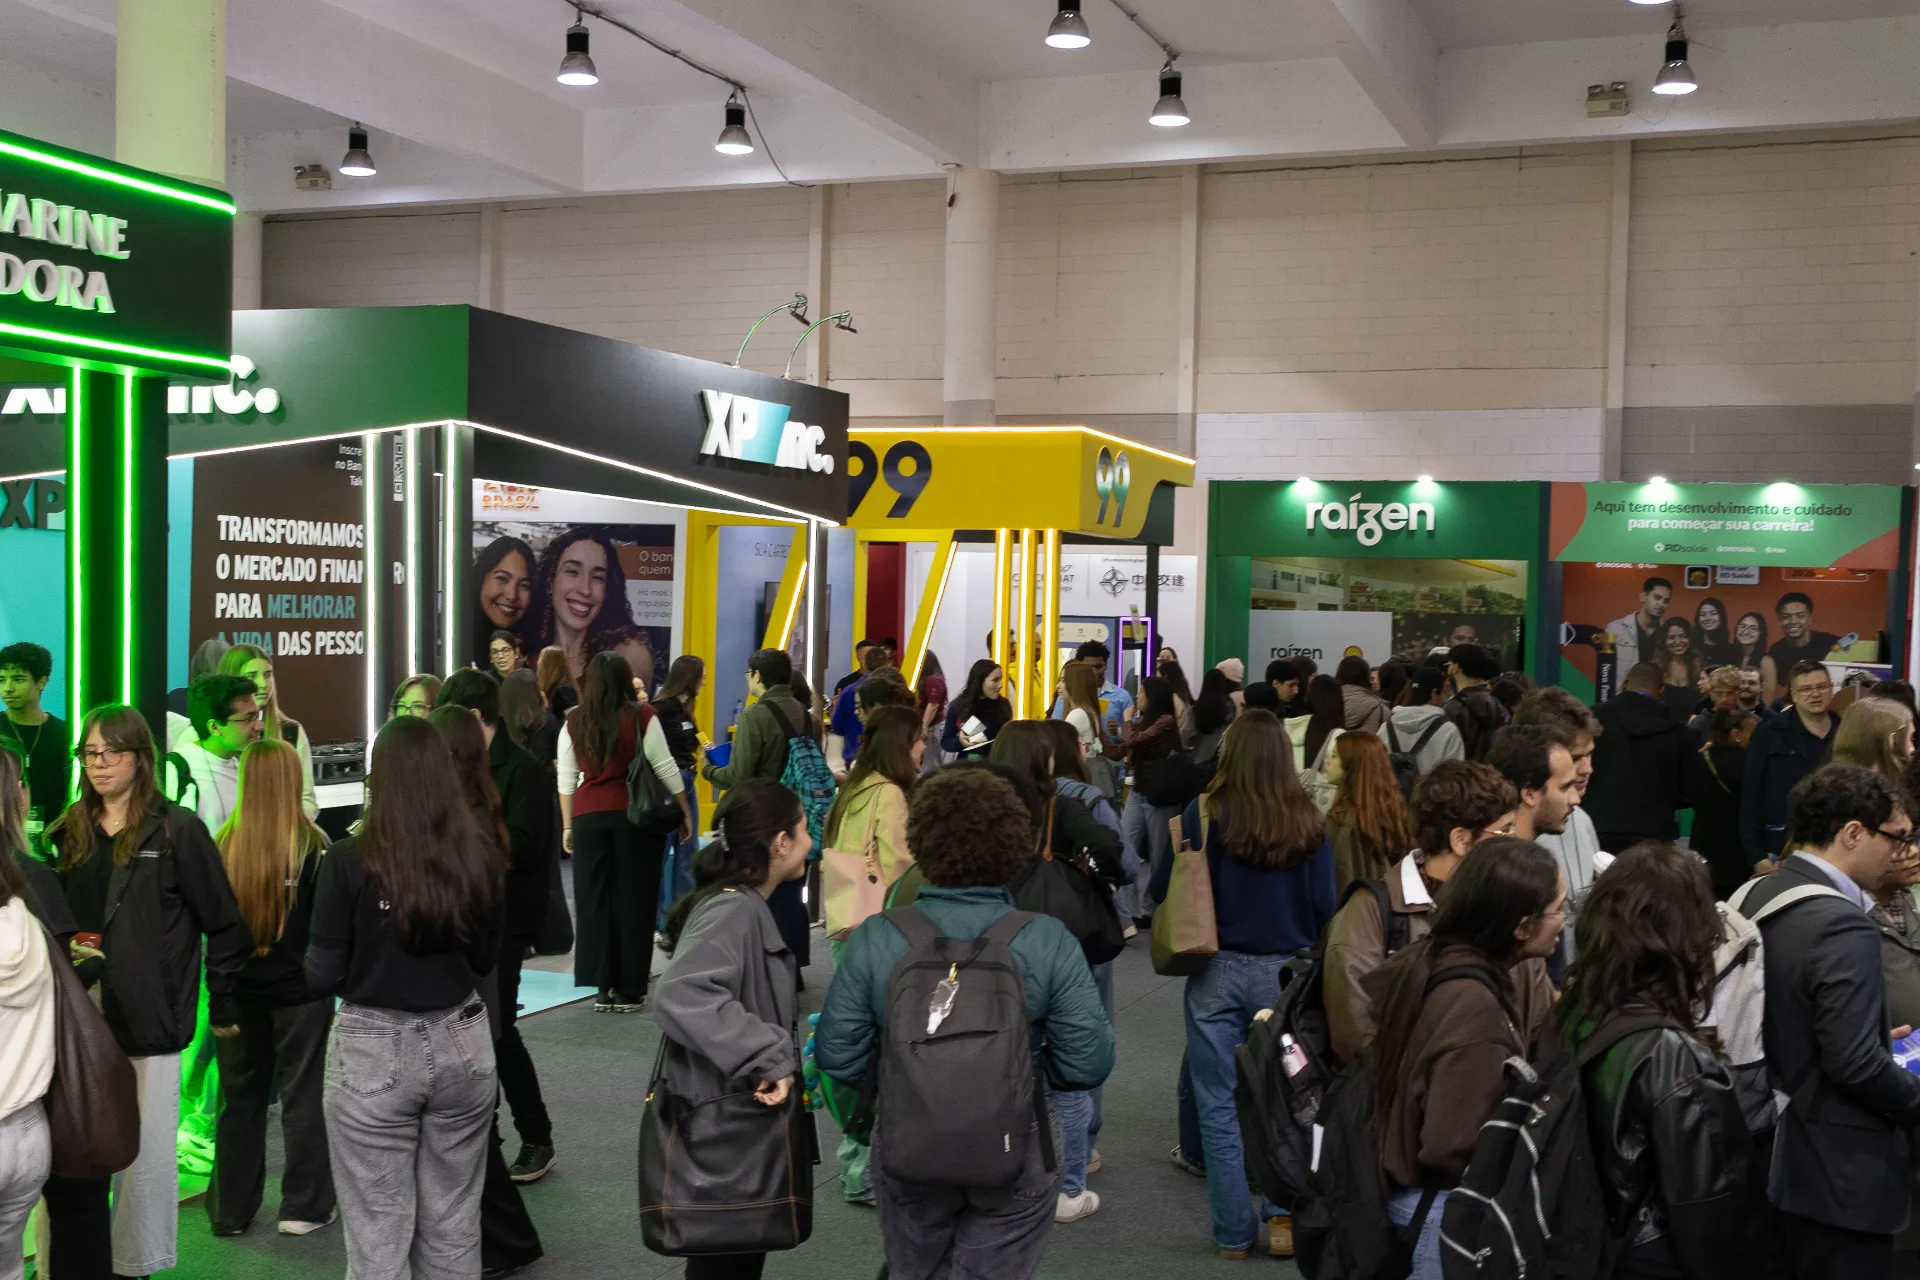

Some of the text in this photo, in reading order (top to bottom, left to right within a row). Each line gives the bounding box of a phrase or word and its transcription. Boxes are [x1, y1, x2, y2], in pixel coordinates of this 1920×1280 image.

[0, 188, 131, 260] ARINE
[848, 440, 932, 518] 99
[1095, 446, 1131, 528] 99
[1305, 492, 1436, 547] raízen
[1593, 501, 1853, 516] Aqui tem desenvolvimento e cuidado
[217, 514, 364, 549] TRANSFORMAMOS
[1627, 518, 1815, 533] para começar sua carreira!
[216, 553, 230, 580] O
[234, 554, 317, 583] MERCADO
[639, 550, 649, 562] O
[638, 565, 672, 576] quem
[1132, 573, 1185, 587] 中交建
[215, 592, 356, 619] PARA MELHORAR
[278, 631, 312, 656] DAS
